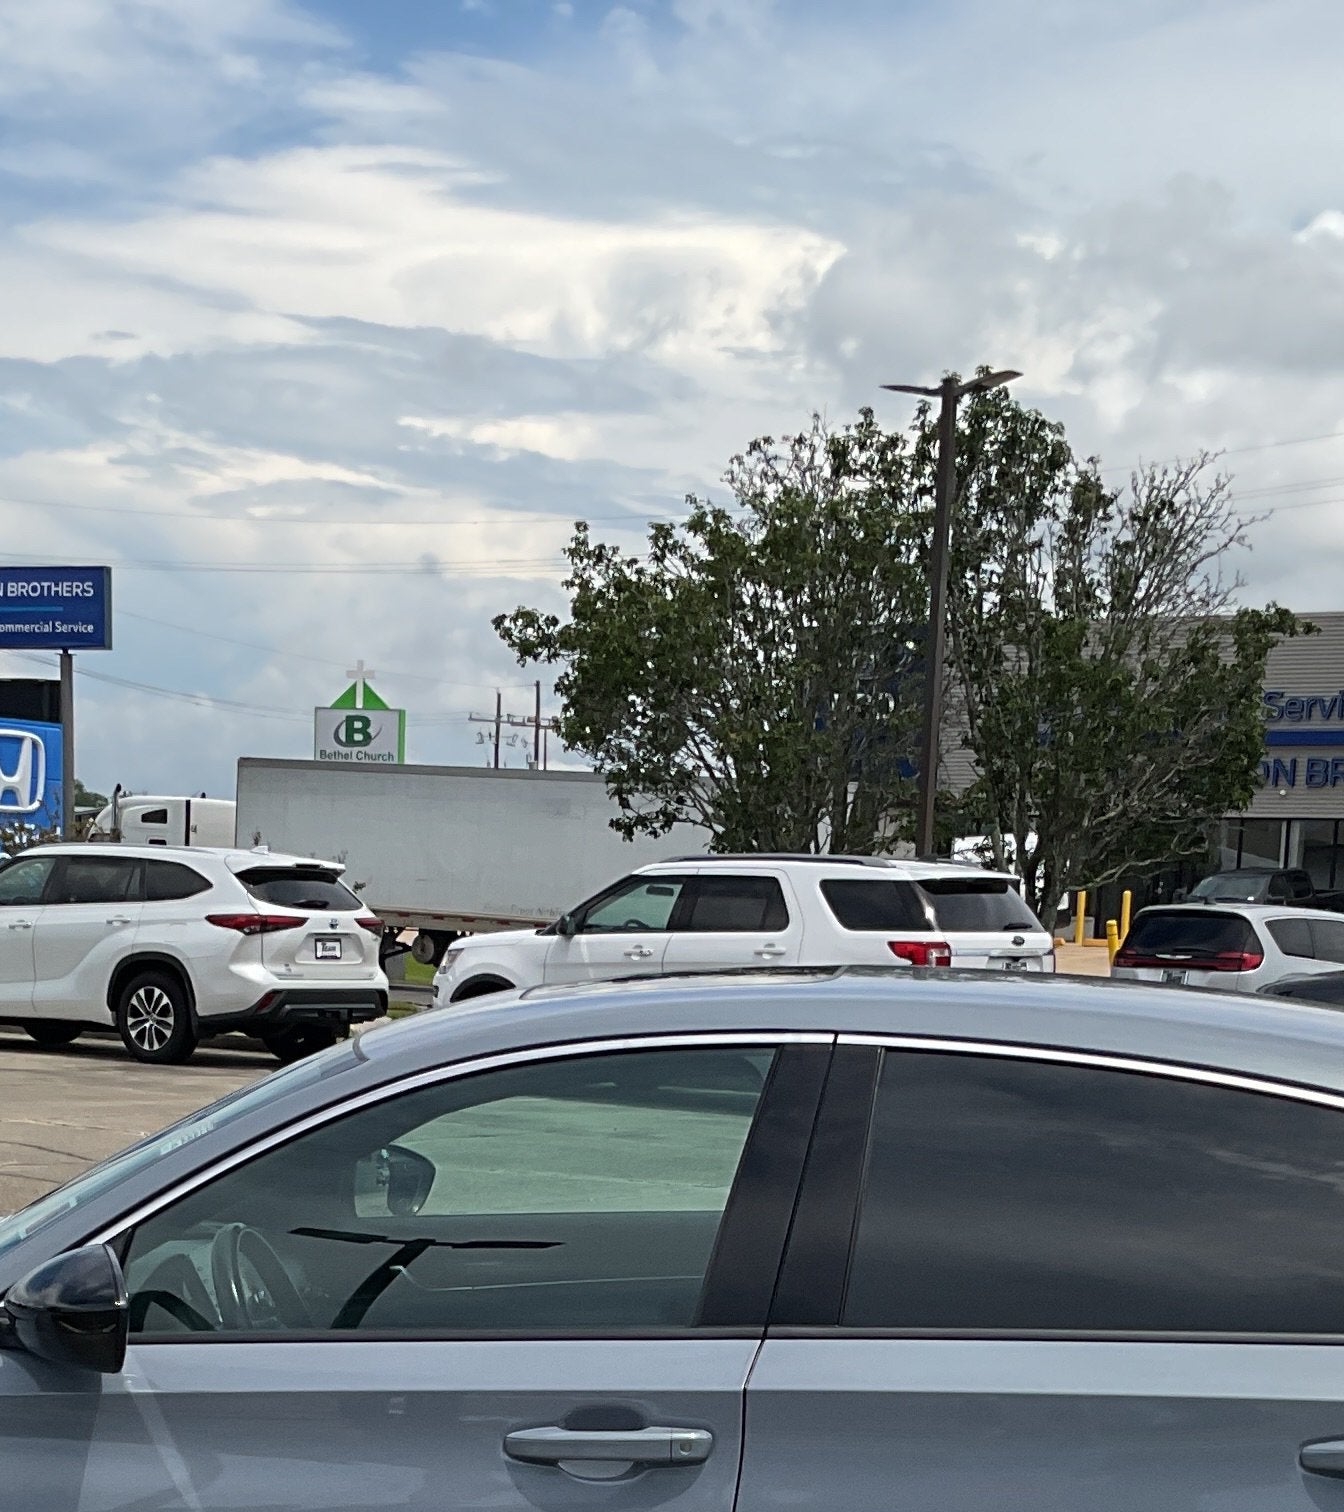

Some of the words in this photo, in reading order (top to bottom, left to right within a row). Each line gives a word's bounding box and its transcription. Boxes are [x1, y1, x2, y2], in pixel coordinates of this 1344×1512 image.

[7, 582, 94, 597] BROTHERS
[56, 621, 94, 632] Service
[319, 750, 352, 760] Bethel
[356, 751, 394, 762] Church
